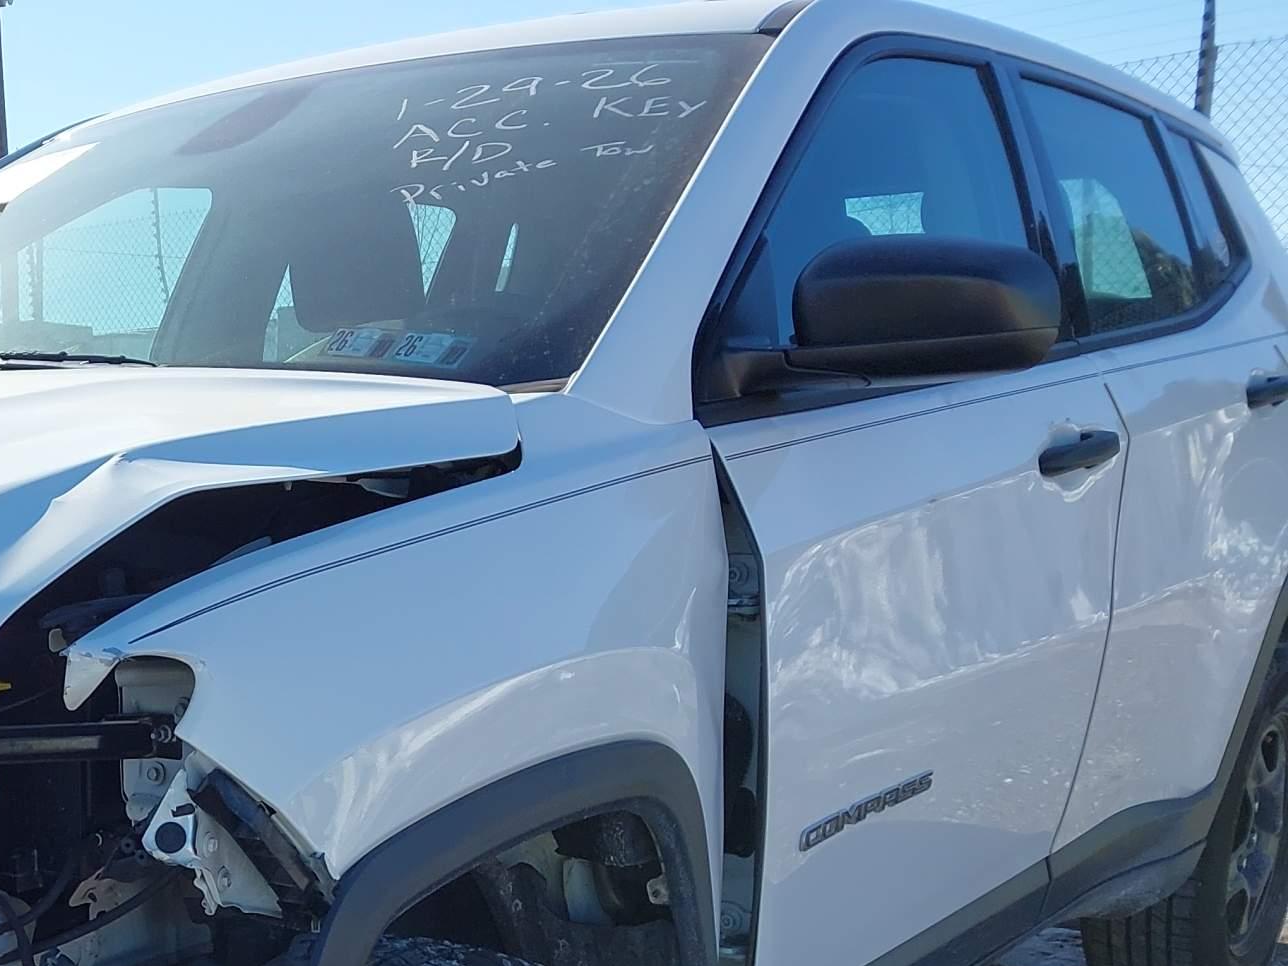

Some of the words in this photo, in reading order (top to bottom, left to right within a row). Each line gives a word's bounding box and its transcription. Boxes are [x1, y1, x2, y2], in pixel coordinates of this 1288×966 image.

[395, 63, 672, 121] 1-29-26
[592, 96, 708, 119] KEY
[390, 159, 558, 203] Private
[580, 141, 655, 157] Tow
[328, 329, 354, 352] 26
[395, 334, 423, 357] 26
[798, 768, 935, 852] COMPASS
